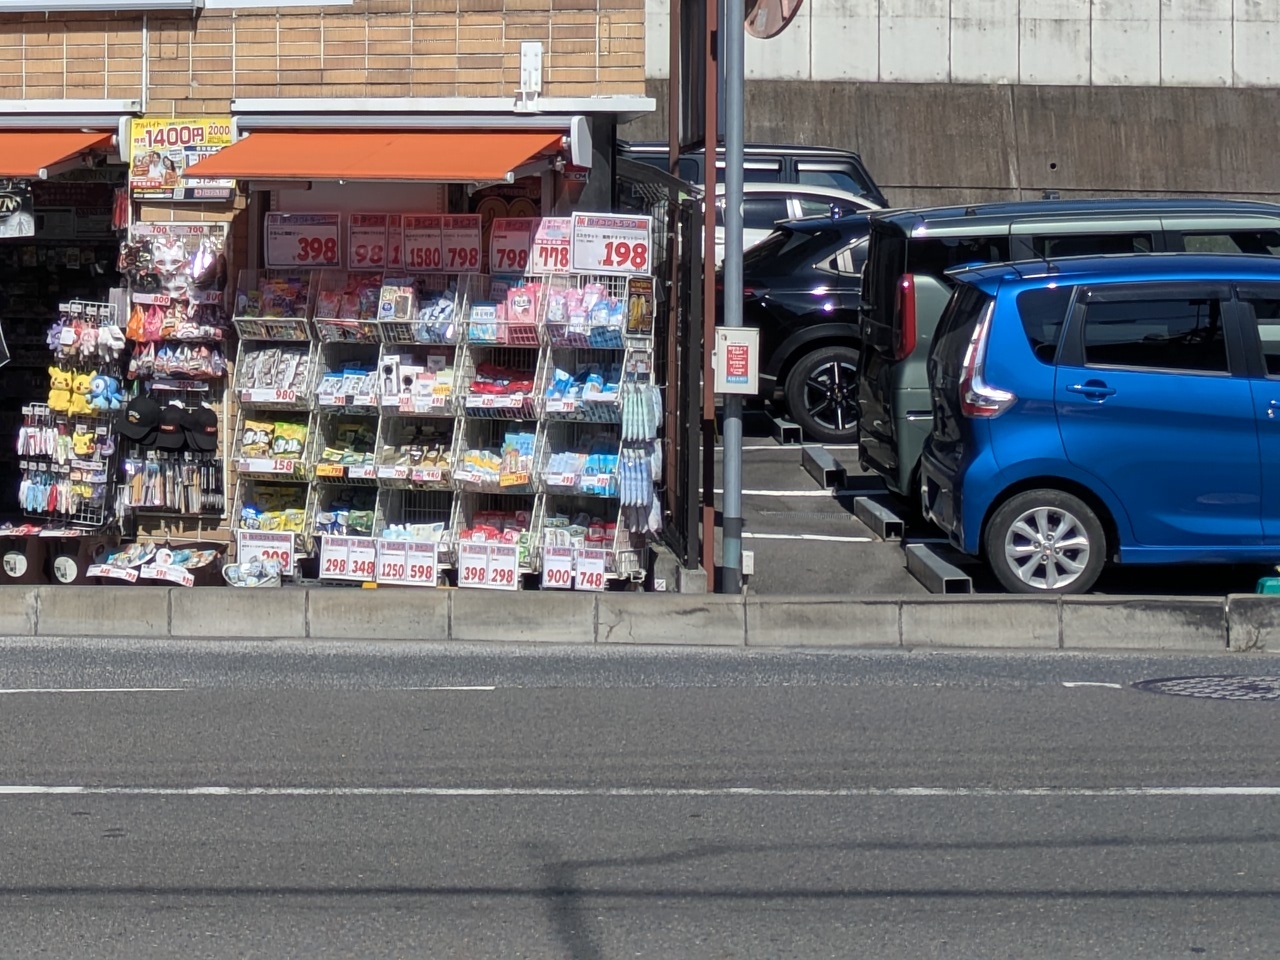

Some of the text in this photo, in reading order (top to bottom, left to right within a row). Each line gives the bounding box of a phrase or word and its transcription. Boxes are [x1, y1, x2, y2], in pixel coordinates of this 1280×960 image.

[152, 226, 167, 234] 700
[187, 226, 204, 234] 700
[409, 247, 441, 268] 1580
[447, 247, 479, 268] 798
[496, 248, 528, 269] 798
[539, 246, 569, 268] 778
[275, 390, 295, 401] 980
[272, 459, 293, 471] 158
[324, 558, 346, 573] 298
[352, 560, 375, 574] 348
[382, 563, 404, 578] 1250
[410, 565, 433, 579] 598
[464, 566, 486, 581] 398
[491, 568, 514, 583] 298
[547, 569, 570, 584] 900
[580, 571, 602, 587] 748
